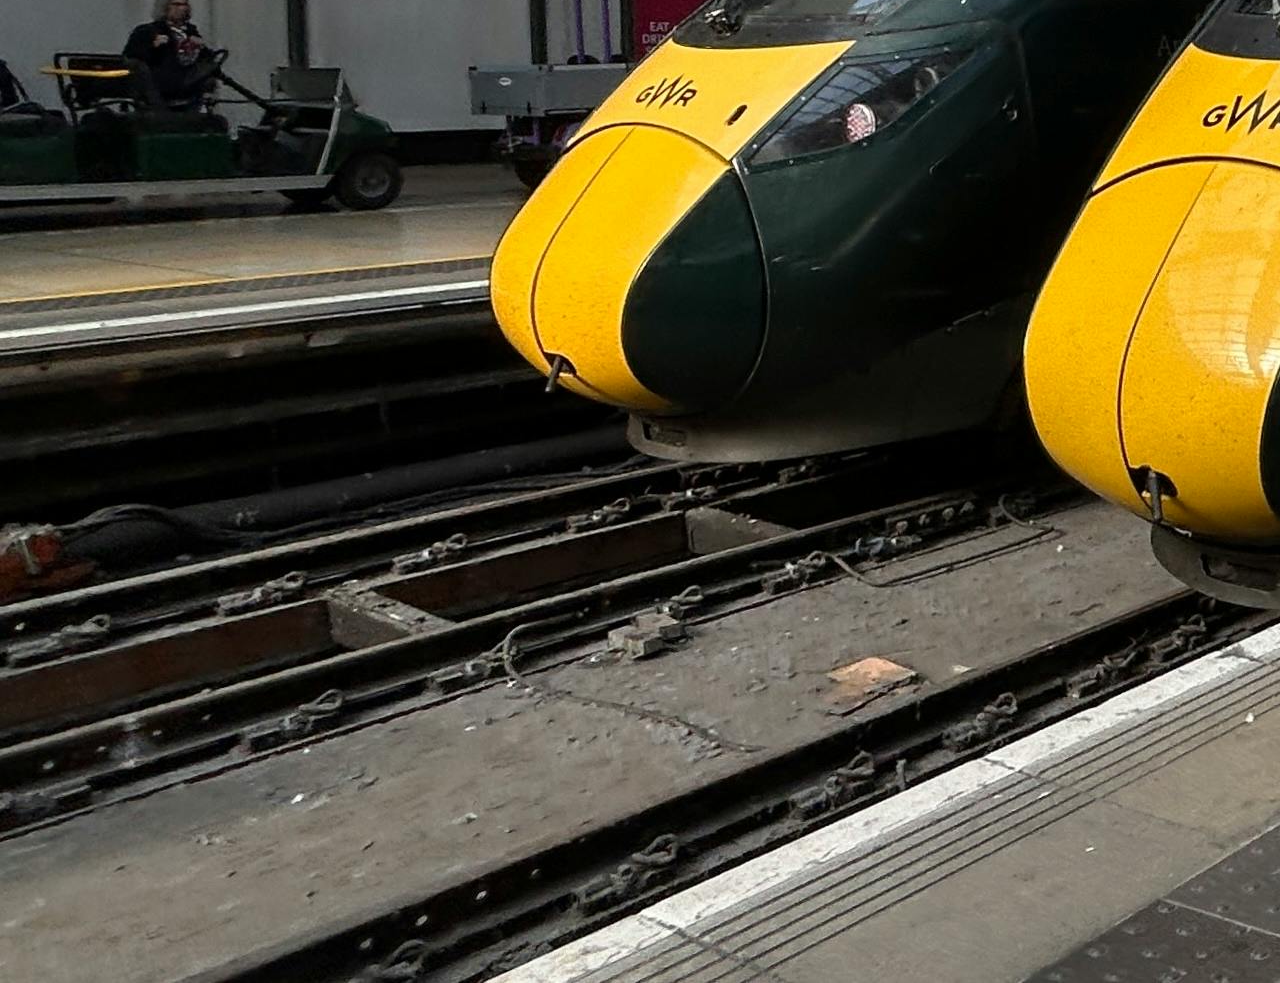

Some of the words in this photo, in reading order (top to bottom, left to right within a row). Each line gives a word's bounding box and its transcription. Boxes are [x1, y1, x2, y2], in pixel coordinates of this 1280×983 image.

[650, 21, 670, 32] EAT
[642, 33, 665, 44] DRI
[635, 73, 698, 110] GWR
